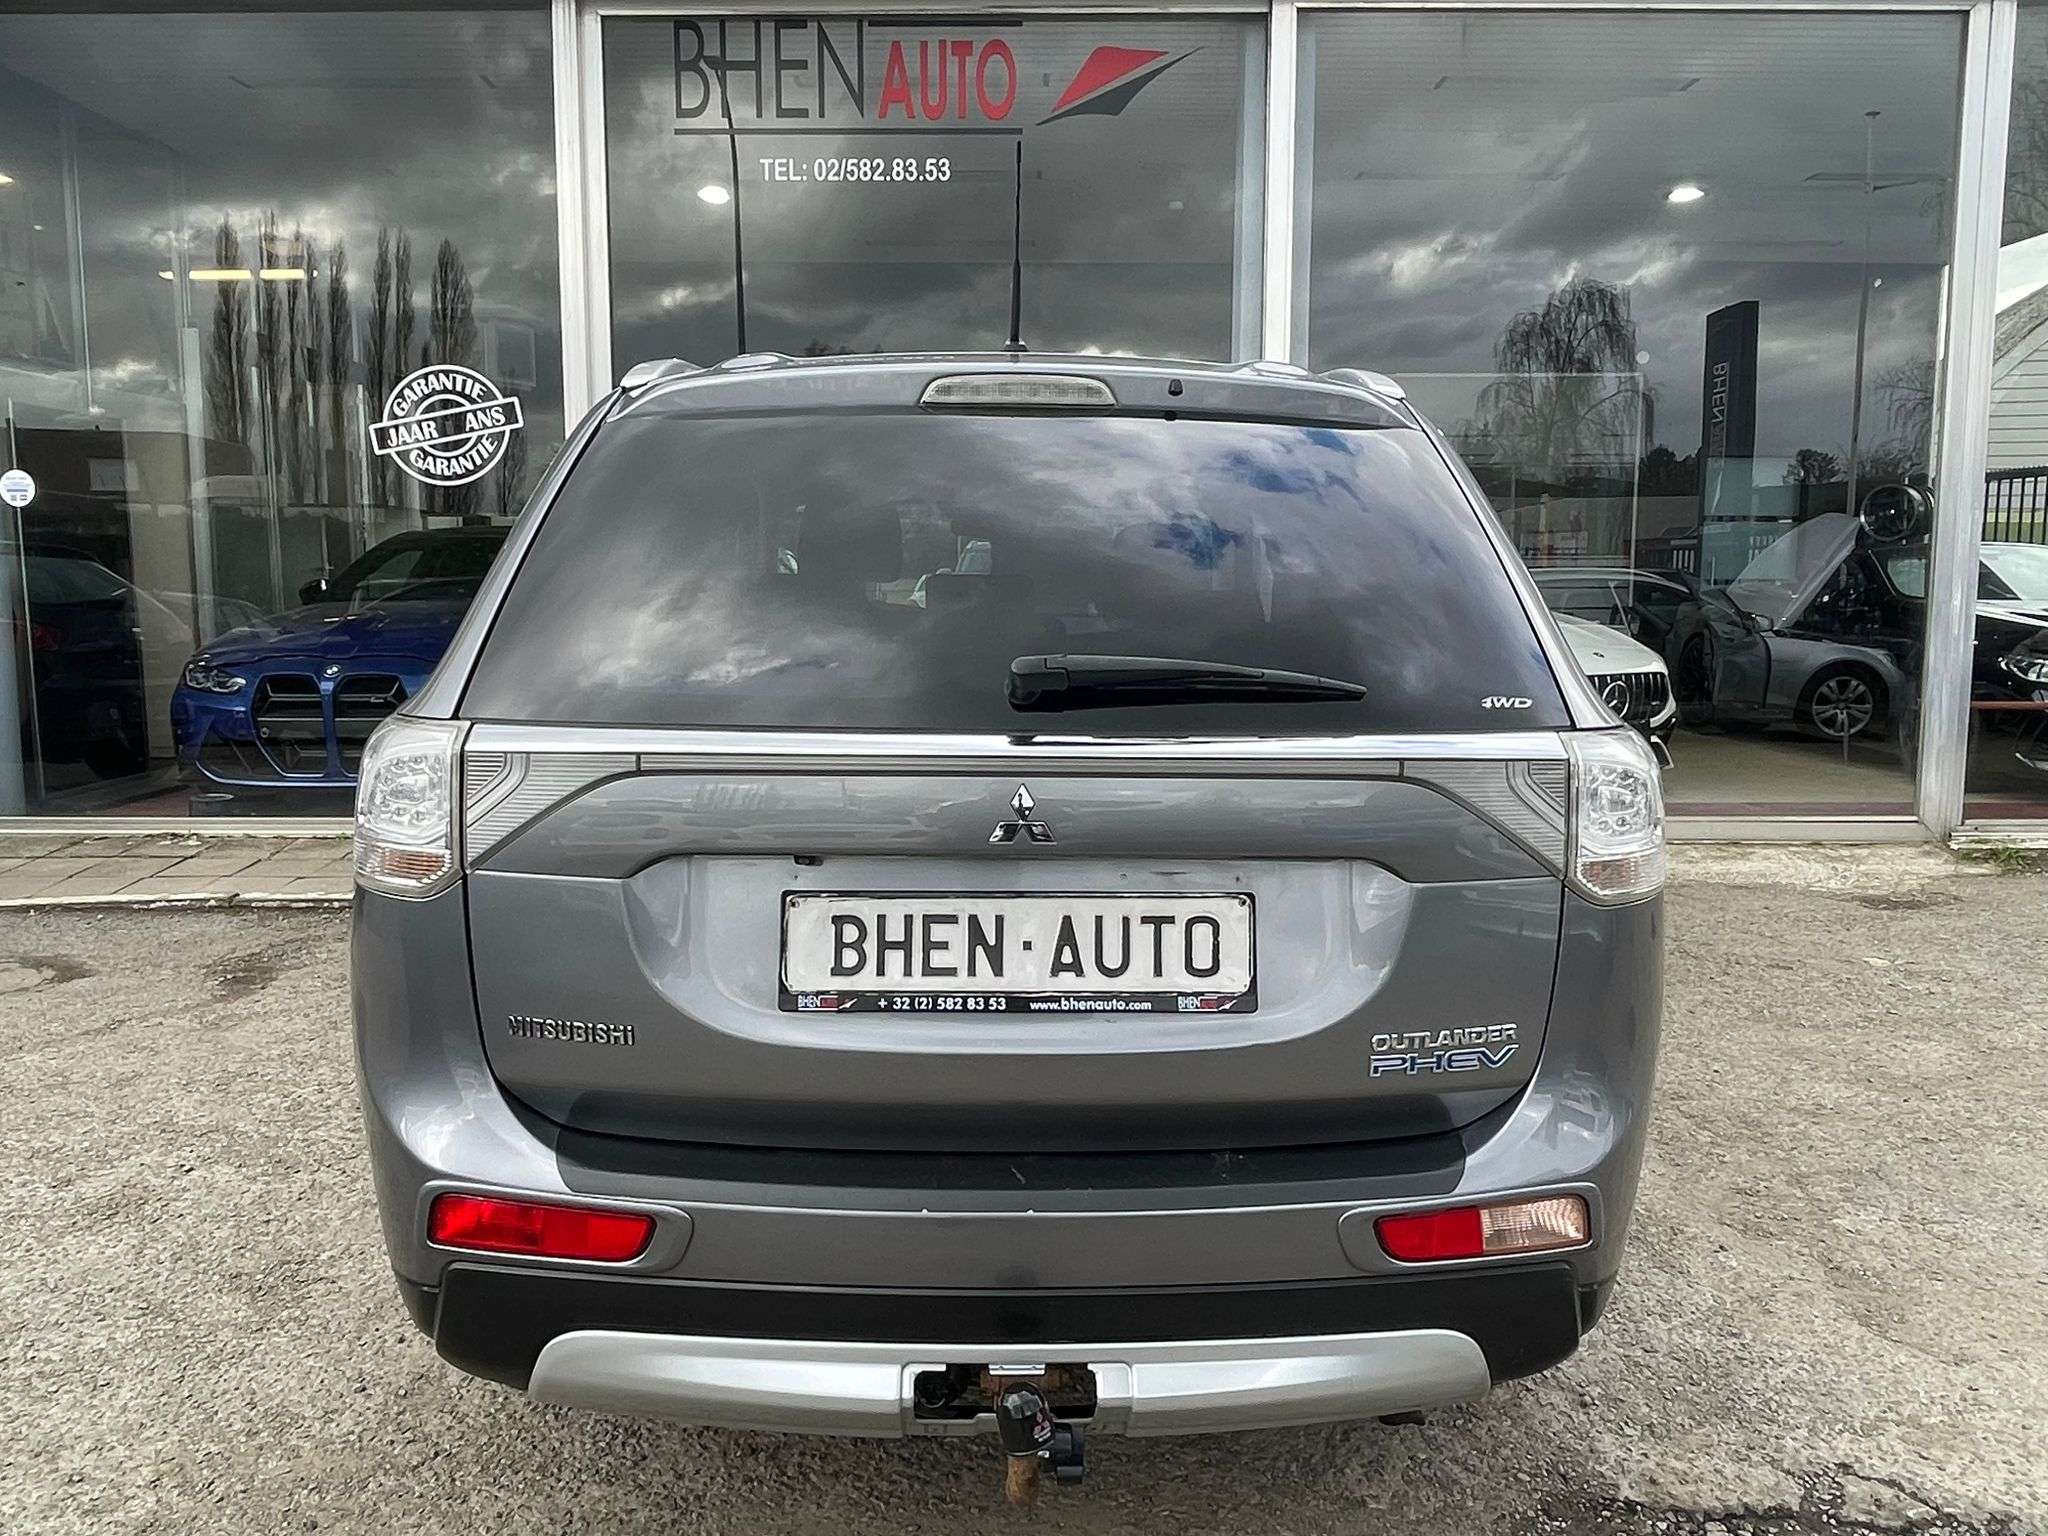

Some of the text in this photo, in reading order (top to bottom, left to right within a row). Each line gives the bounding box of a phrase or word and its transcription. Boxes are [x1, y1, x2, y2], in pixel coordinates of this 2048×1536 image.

[673, 19, 1018, 120] BHEN AUTO
[759, 157, 951, 182] TEL: 02/582.83.53
[392, 372, 488, 418] GARANTIE
[387, 406, 506, 448] JAAR ANS
[408, 433, 499, 477] GARANTIE
[830, 913, 1222, 978] BHEN AUTO
[892, 997, 911, 1010] 32
[914, 997, 933, 1011] (2)
[936, 997, 963, 1011] 582
[966, 997, 985, 1011] 83
[988, 997, 1007, 1011] 53
[1029, 997, 1151, 1011] www.bhenauto.com
[508, 1015, 635, 1046] MITSUBISHI
[1371, 1023, 1518, 1052] OUTLANDER
[1369, 1044, 1520, 1078] PHEV
